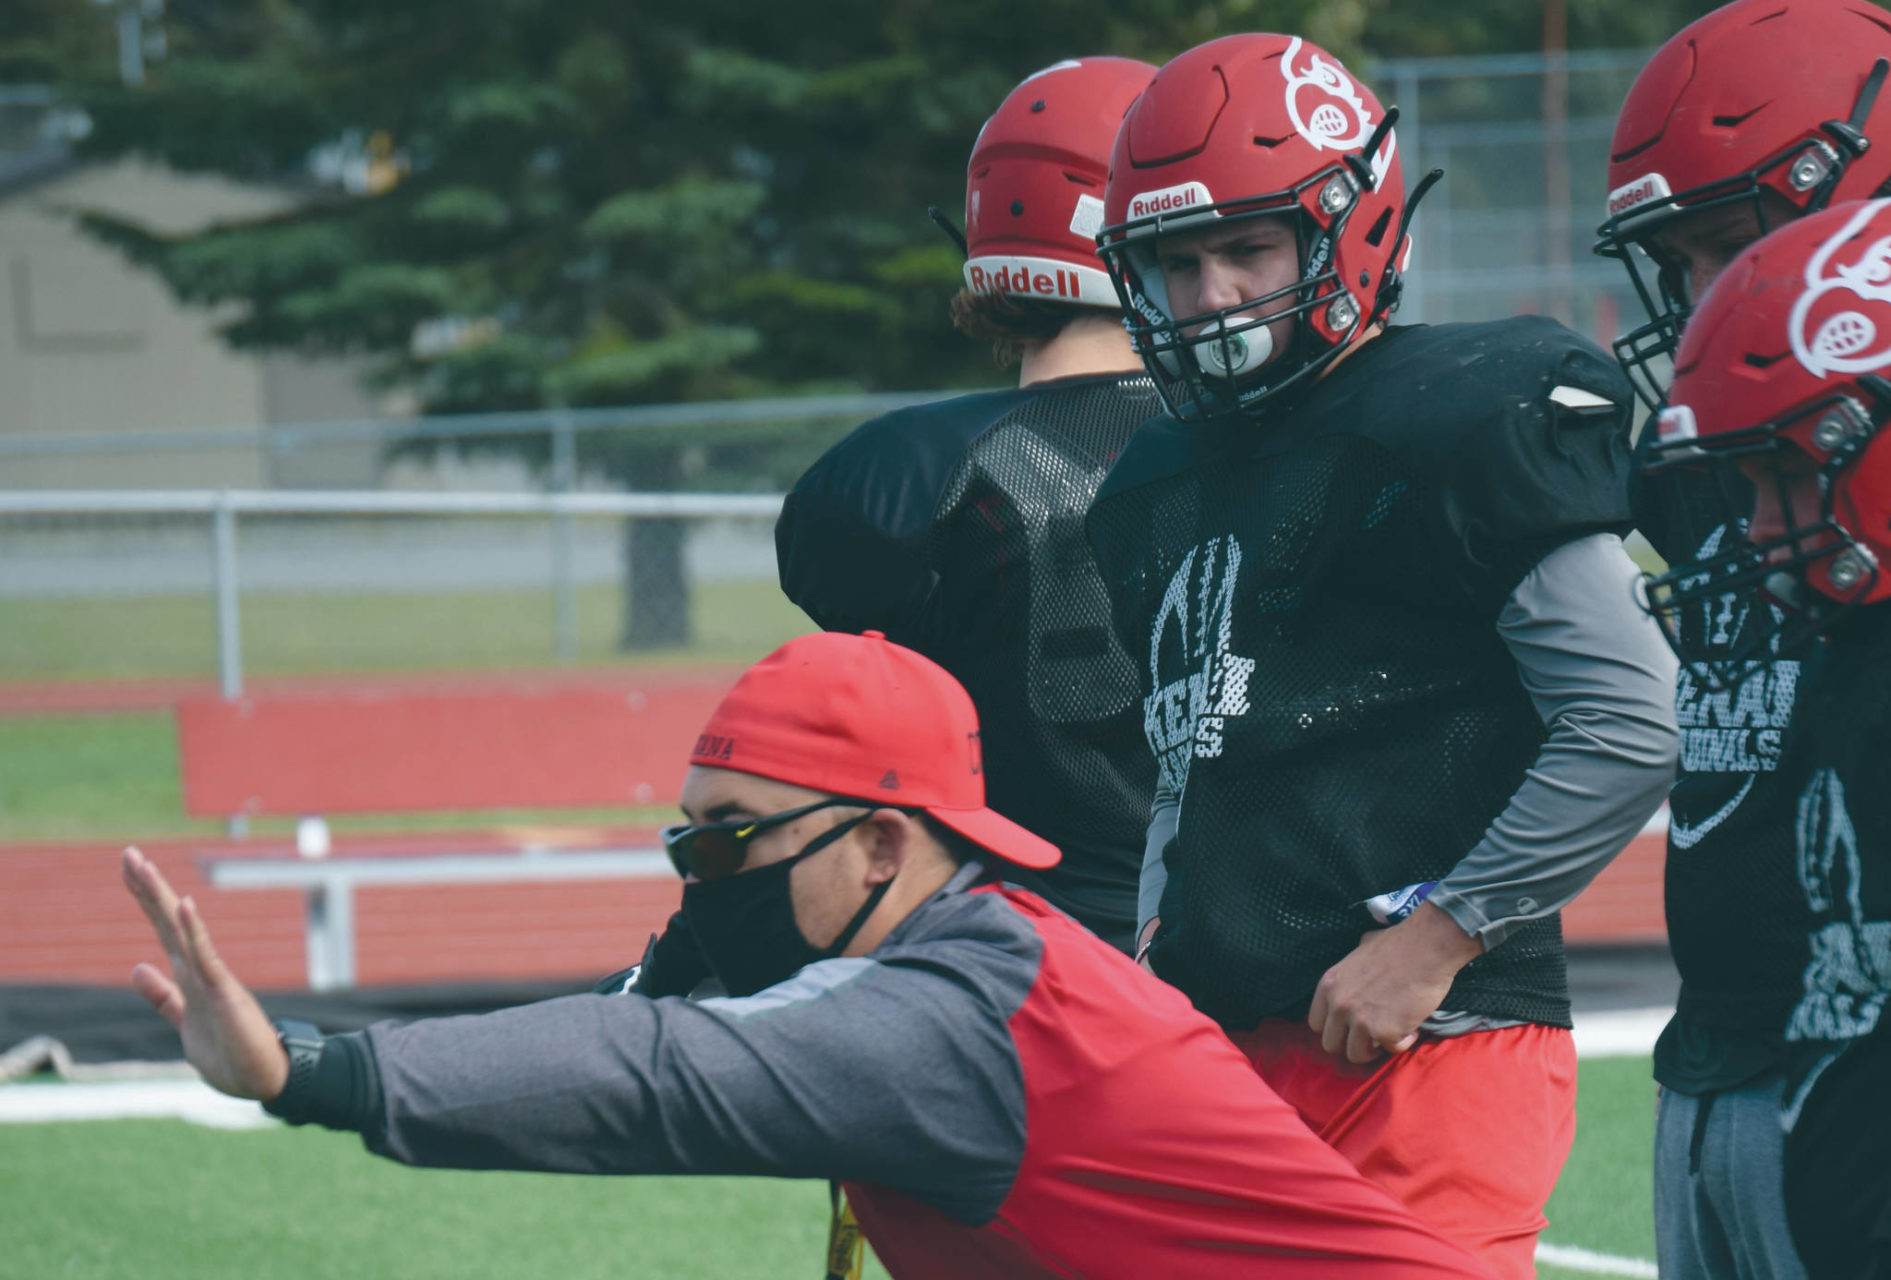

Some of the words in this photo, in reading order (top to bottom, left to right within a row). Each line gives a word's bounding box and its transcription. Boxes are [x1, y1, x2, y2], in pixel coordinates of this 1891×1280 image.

[1132, 187, 1197, 217] Riddell
[969, 264, 1081, 299] Riddell
[1675, 661, 1800, 727] ENAI
